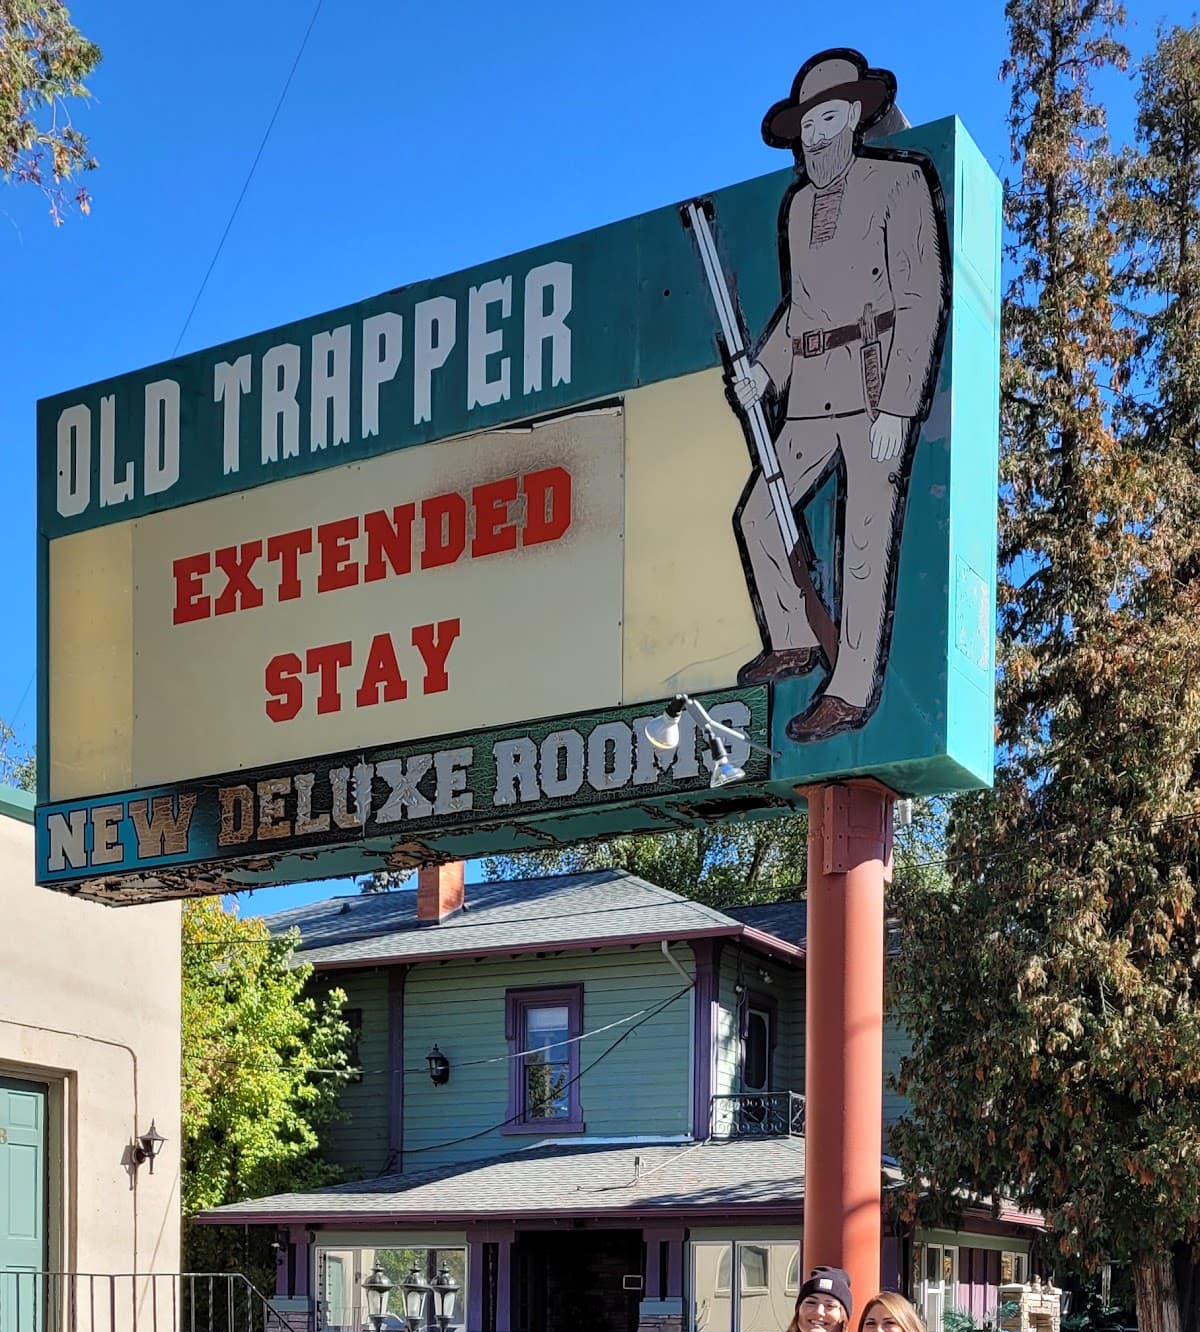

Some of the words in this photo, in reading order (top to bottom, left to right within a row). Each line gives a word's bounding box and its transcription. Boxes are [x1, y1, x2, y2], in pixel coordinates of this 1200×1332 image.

[57, 378, 180, 518] OLD
[214, 261, 572, 475] TRAPPER
[173, 466, 571, 625] EXTENDED
[265, 618, 460, 722] STAY
[47, 793, 197, 872] NEW
[217, 748, 473, 847] DELUXE
[493, 701, 751, 806] ROOMS
